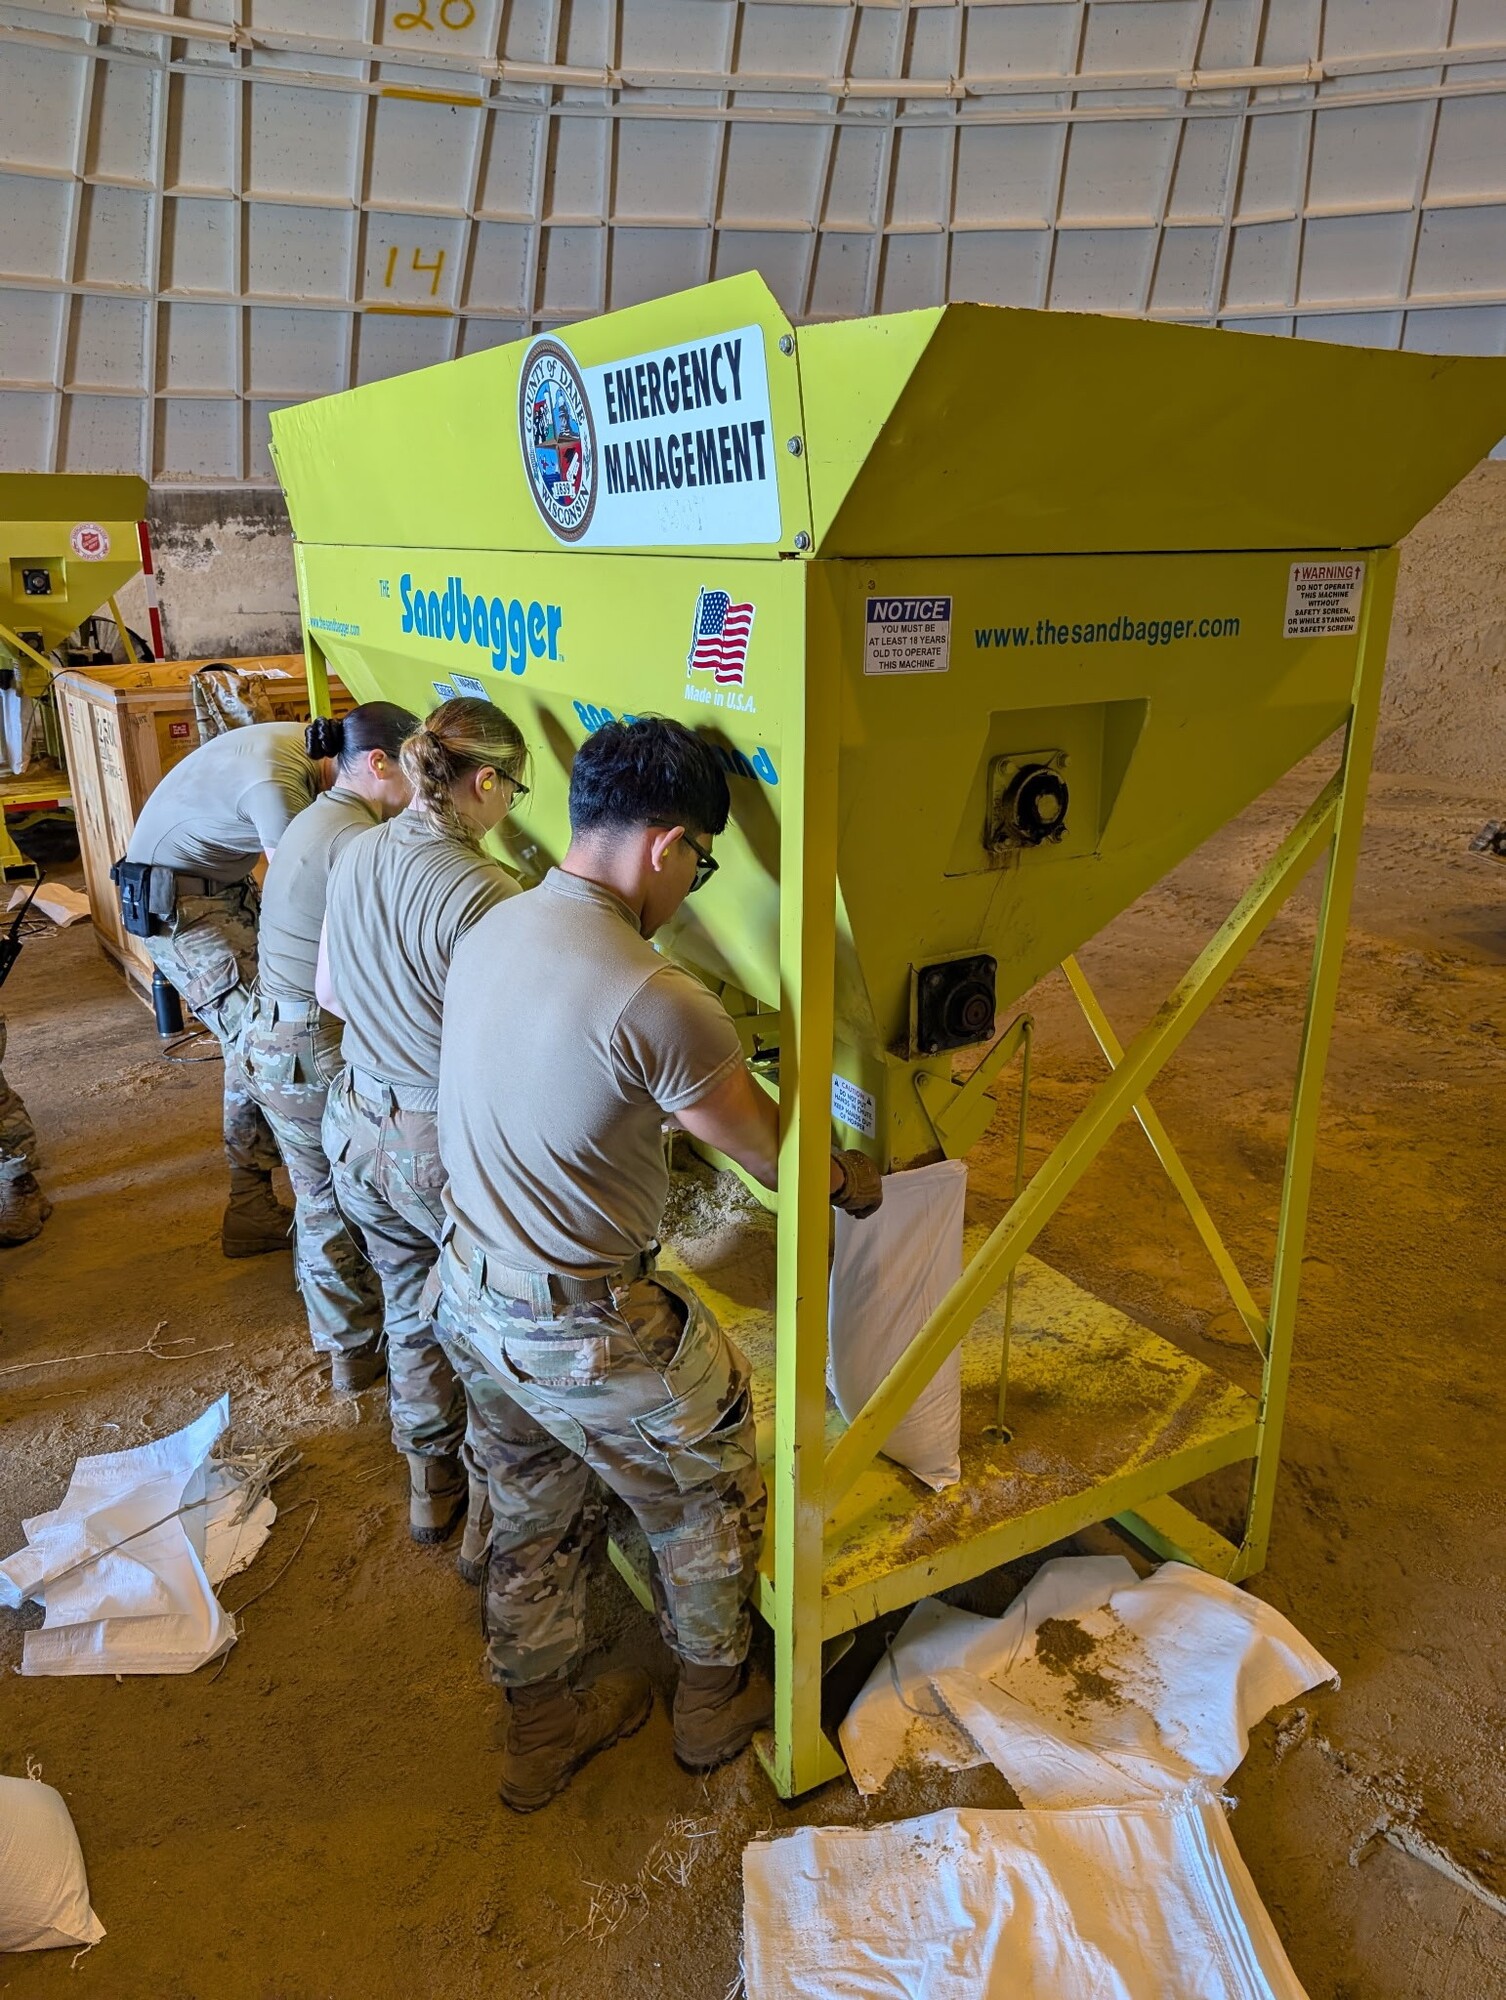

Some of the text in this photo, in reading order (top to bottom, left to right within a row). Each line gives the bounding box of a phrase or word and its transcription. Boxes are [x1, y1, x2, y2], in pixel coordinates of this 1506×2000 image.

[393, 0, 475, 30] 20
[384, 246, 445, 296] 14
[604, 338, 742, 424] EMERGENCY
[525, 365, 545, 433] COUNTY
[559, 365, 586, 426] DANE
[604, 420, 766, 494] MANAGEMENT
[556, 482, 571, 496] 1839
[541, 482, 590, 526] WISCONSIN
[1302, 566, 1353, 579] WARNING
[874, 601, 946, 620] NOTICE
[379, 580, 390, 598] THE
[400, 574, 562, 675] Sandbagger
[882, 624, 935, 633] YOU MUST BE
[974, 616, 1240, 648] www.thesandbagger.com
[869, 636, 946, 646] AT LEAST 18 YEARS
[873, 648, 941, 658] OLD TO OPERATE
[879, 659, 935, 669] THIS MACHINE
[684, 684, 756, 713] Made in U.S.A.
[835, 1093, 850, 1106] HANDS
[840, 1089, 866, 1109] DO NOT PUT
[842, 1082, 864, 1099] CAUTION
[834, 1102, 872, 1128] KEEP HANDS OUT
[847, 1116, 864, 1131] HOPPER
